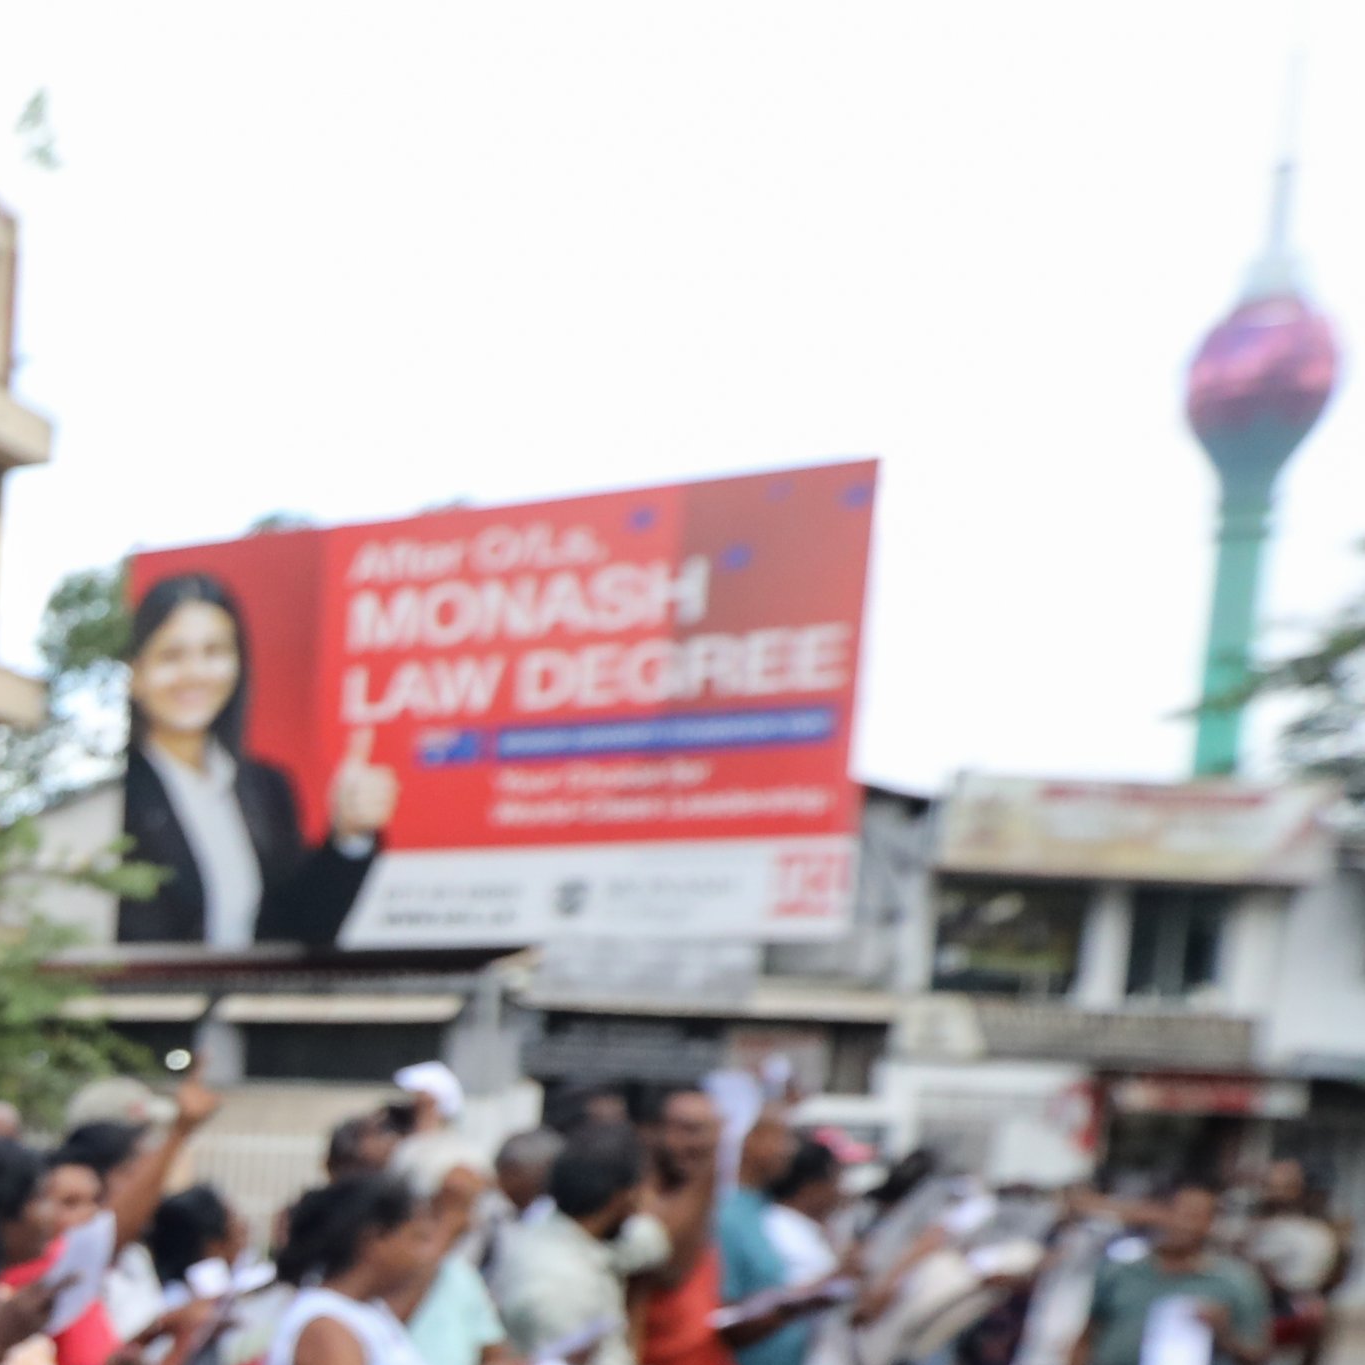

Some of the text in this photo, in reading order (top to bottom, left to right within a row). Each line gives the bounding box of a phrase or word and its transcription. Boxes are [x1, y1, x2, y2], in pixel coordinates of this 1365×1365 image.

[345, 555, 711, 653] MONASH
[347, 540, 463, 585] After
[341, 620, 853, 724] LAW DEGREE
